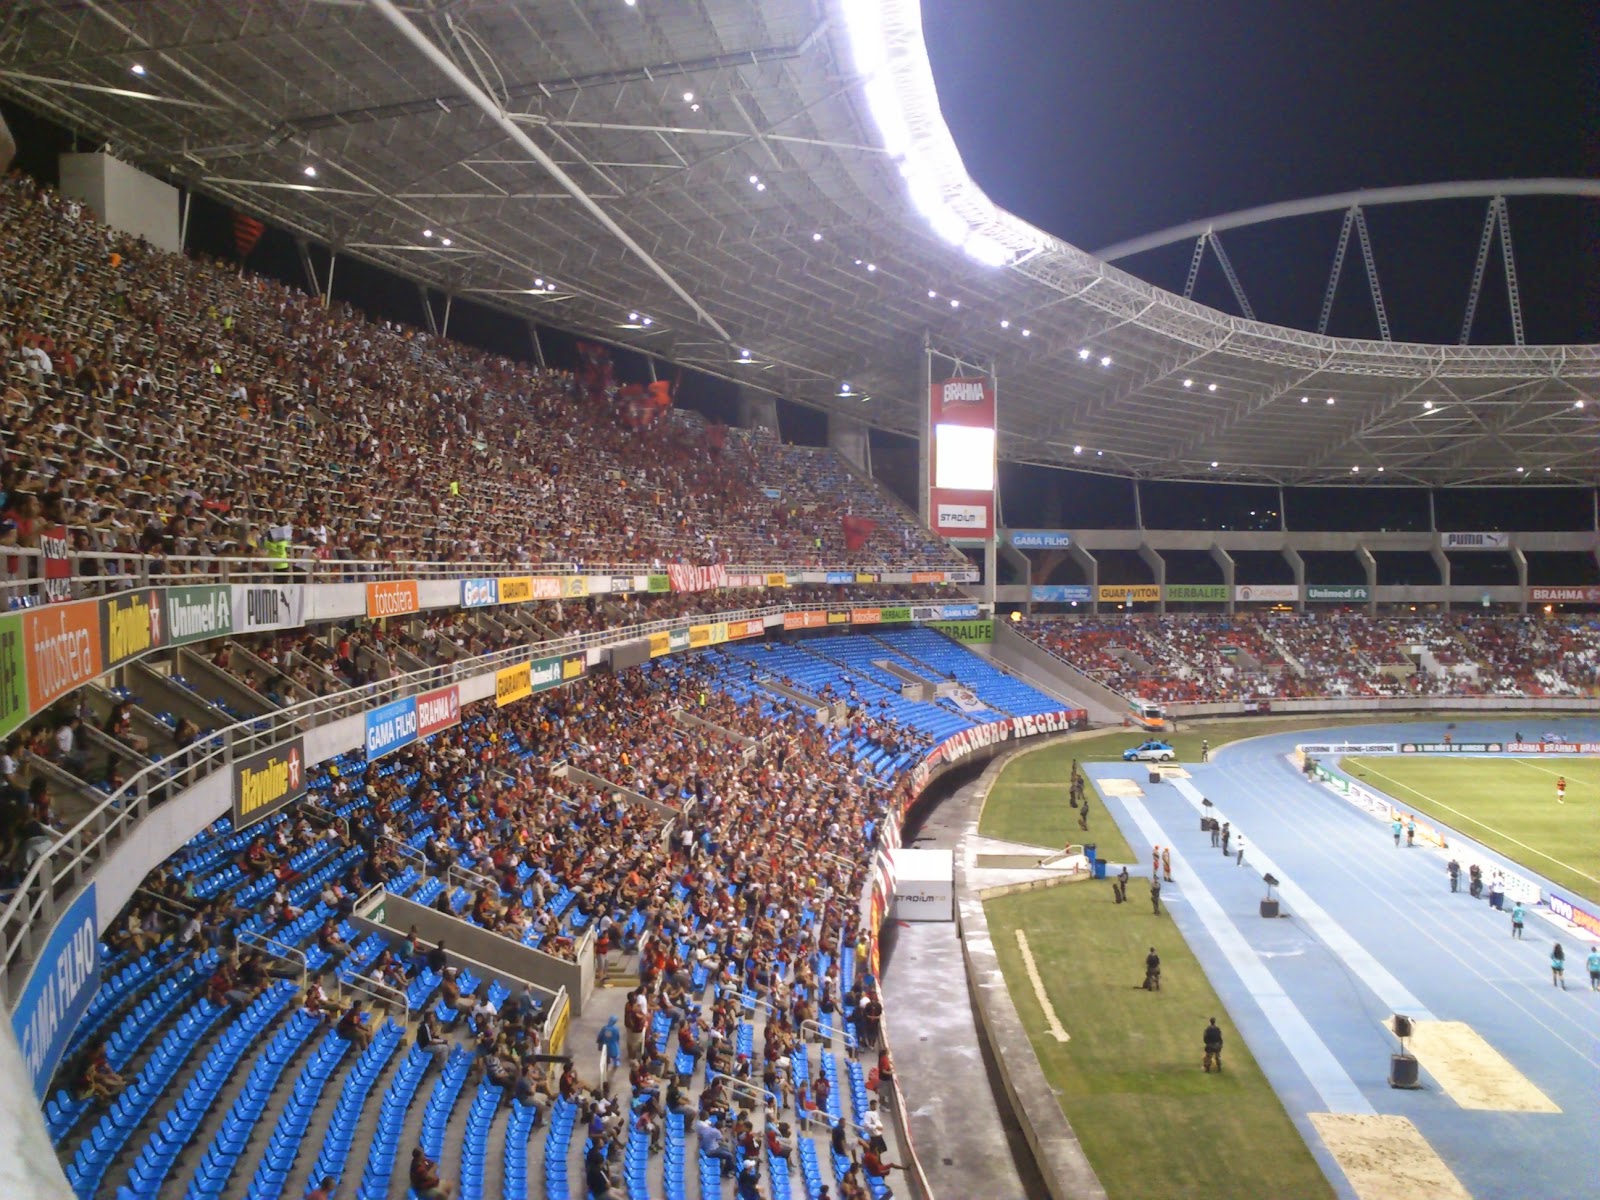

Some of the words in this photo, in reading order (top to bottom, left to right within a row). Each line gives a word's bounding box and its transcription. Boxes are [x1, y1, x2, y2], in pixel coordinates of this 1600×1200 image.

[944, 383, 984, 402] BRAHMA
[941, 514, 975, 522] STADIUM
[1013, 536, 1042, 545] GAMA
[1044, 537, 1069, 546] FILHO
[1449, 534, 1483, 545] PUMA
[375, 584, 412, 614] fotosfera
[1101, 588, 1158, 598] GUARAVITON
[1169, 588, 1226, 598] HERBALIFE
[1309, 588, 1350, 598] Unimed
[1534, 589, 1583, 600] BRAHMA
[169, 592, 215, 638] Unimed
[247, 589, 279, 625] PUMA
[882, 609, 910, 618] HERBALIFE
[33, 610, 92, 701] fotosfera
[419, 696, 449, 729] BRAHMA
[369, 720, 395, 751] GAMA
[395, 710, 416, 739] FILHO
[1507, 743, 1540, 752] BRAHMA
[1544, 743, 1577, 752] BRAHMA
[241, 757, 288, 816] Havoline
[1550, 896, 1572, 920] VIVO
[58, 917, 94, 1020] FILHO
